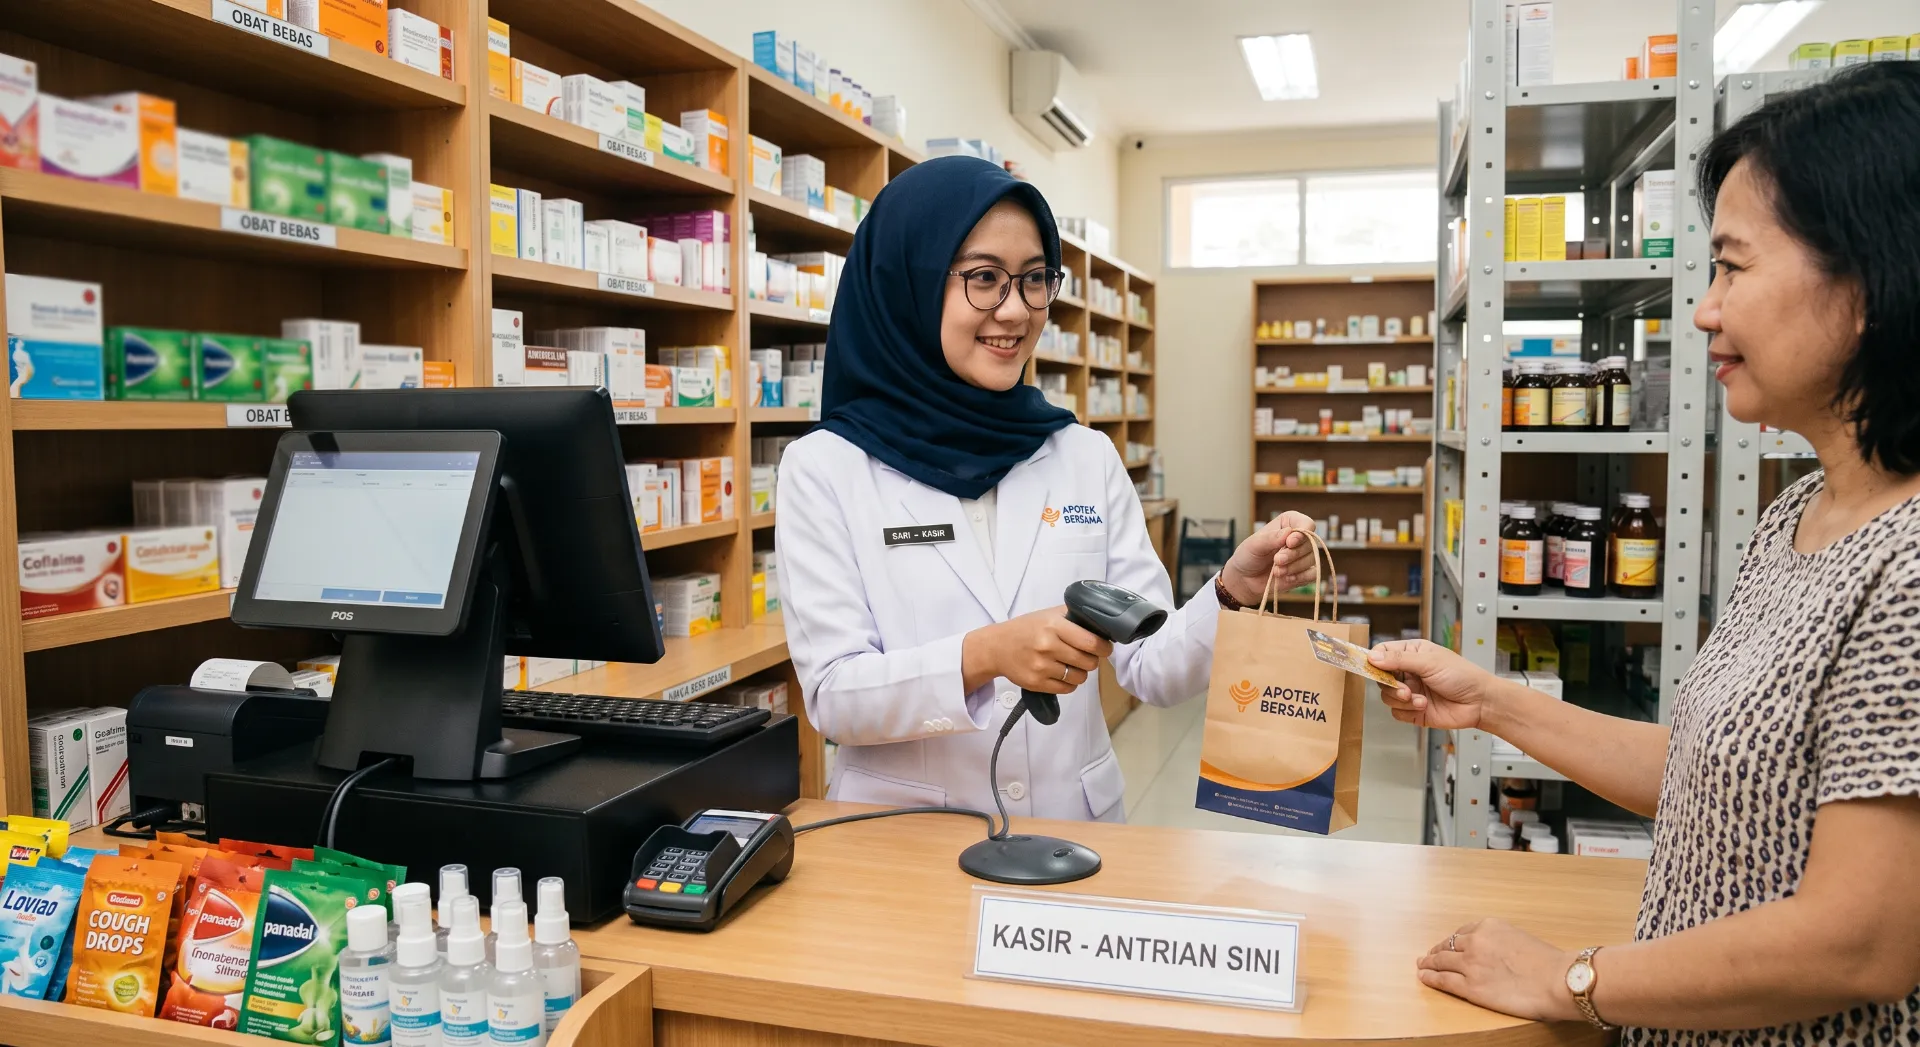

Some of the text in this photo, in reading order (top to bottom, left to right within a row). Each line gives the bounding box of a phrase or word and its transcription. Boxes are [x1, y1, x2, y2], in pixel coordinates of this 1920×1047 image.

[232, 9, 313, 48] OBAT BEBAS
[240, 215, 320, 241] OBAT BEBAS
[246, 408, 281, 423] OBAT
[1062, 504, 1097, 515] APOTEK
[1064, 514, 1103, 525] BERSAMA
[892, 531, 911, 540] SARI
[922, 529, 946, 538] KASIR
[331, 611, 354, 621] POS
[1262, 685, 1321, 706] APOTEK
[1260, 700, 1327, 723] BERSAMA
[89, 909, 151, 935] COUGH
[199, 912, 242, 929] panadal
[263, 921, 315, 940] panadal
[85, 930, 145, 956] DROPS
[992, 923, 1072, 955] KASIR
[1095, 934, 1217, 969] ANTRIAN
[1226, 945, 1280, 975] SINI
